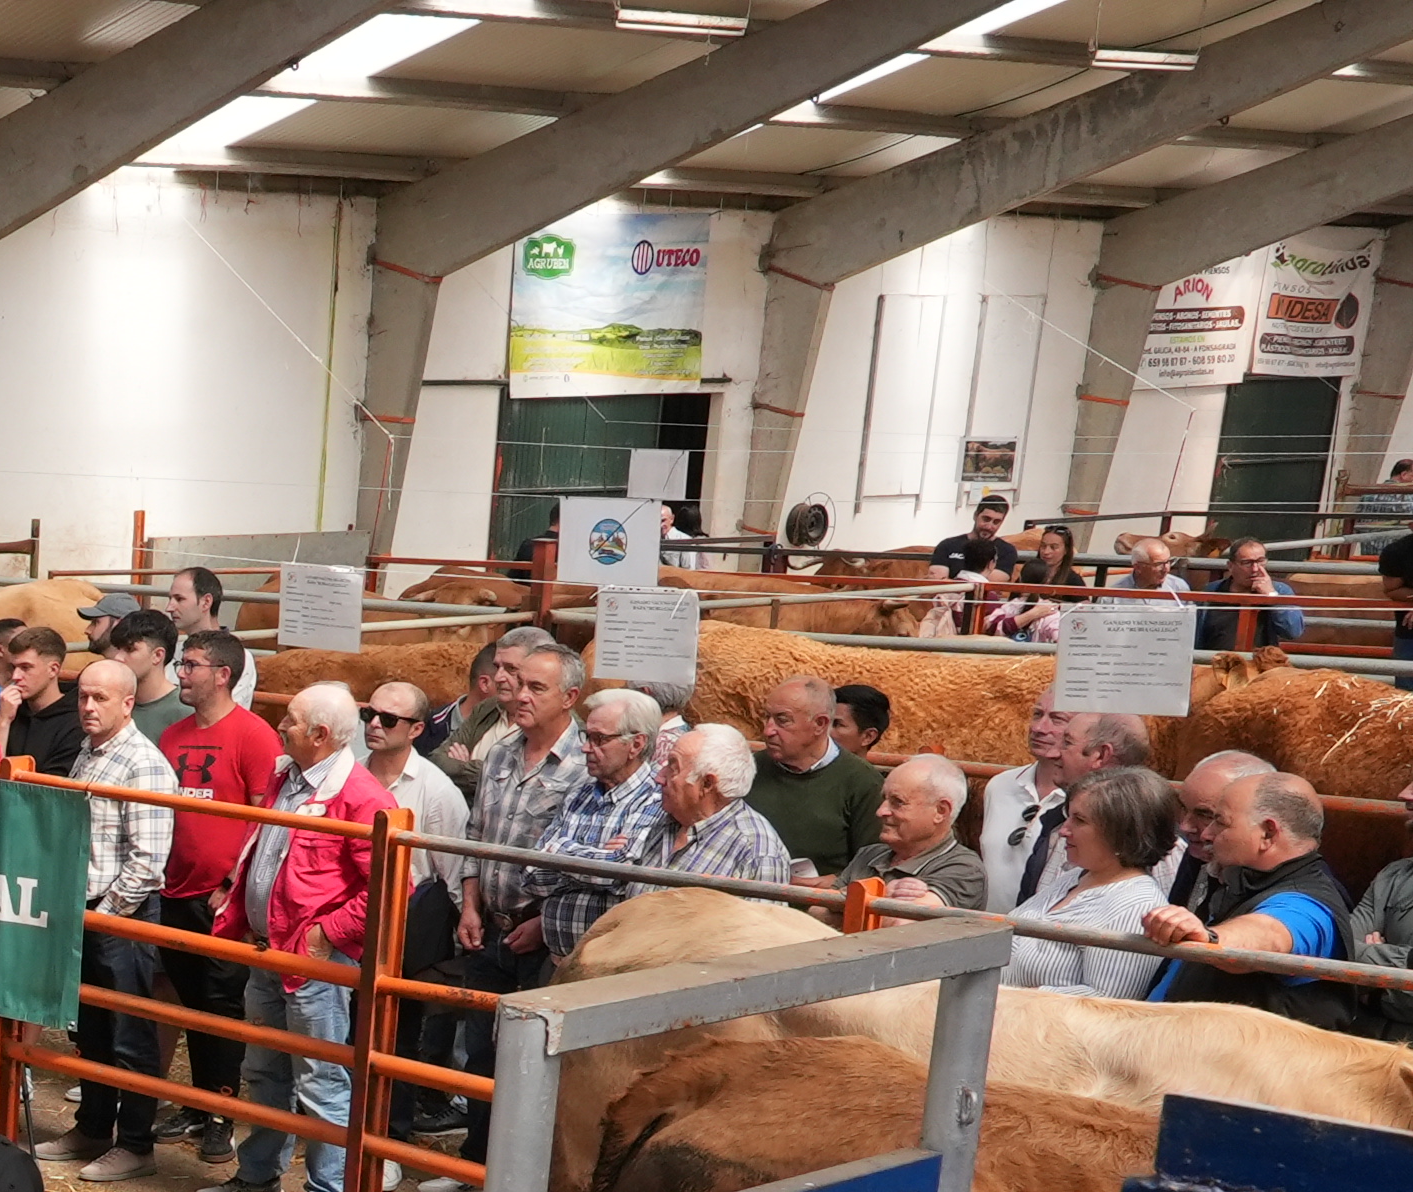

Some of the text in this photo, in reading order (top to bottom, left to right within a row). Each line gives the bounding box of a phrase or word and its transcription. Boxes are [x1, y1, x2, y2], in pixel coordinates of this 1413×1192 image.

[527, 258, 570, 270] AGRUBEN
[656, 247, 701, 268] UTECO
[1173, 277, 1214, 306] ARION
